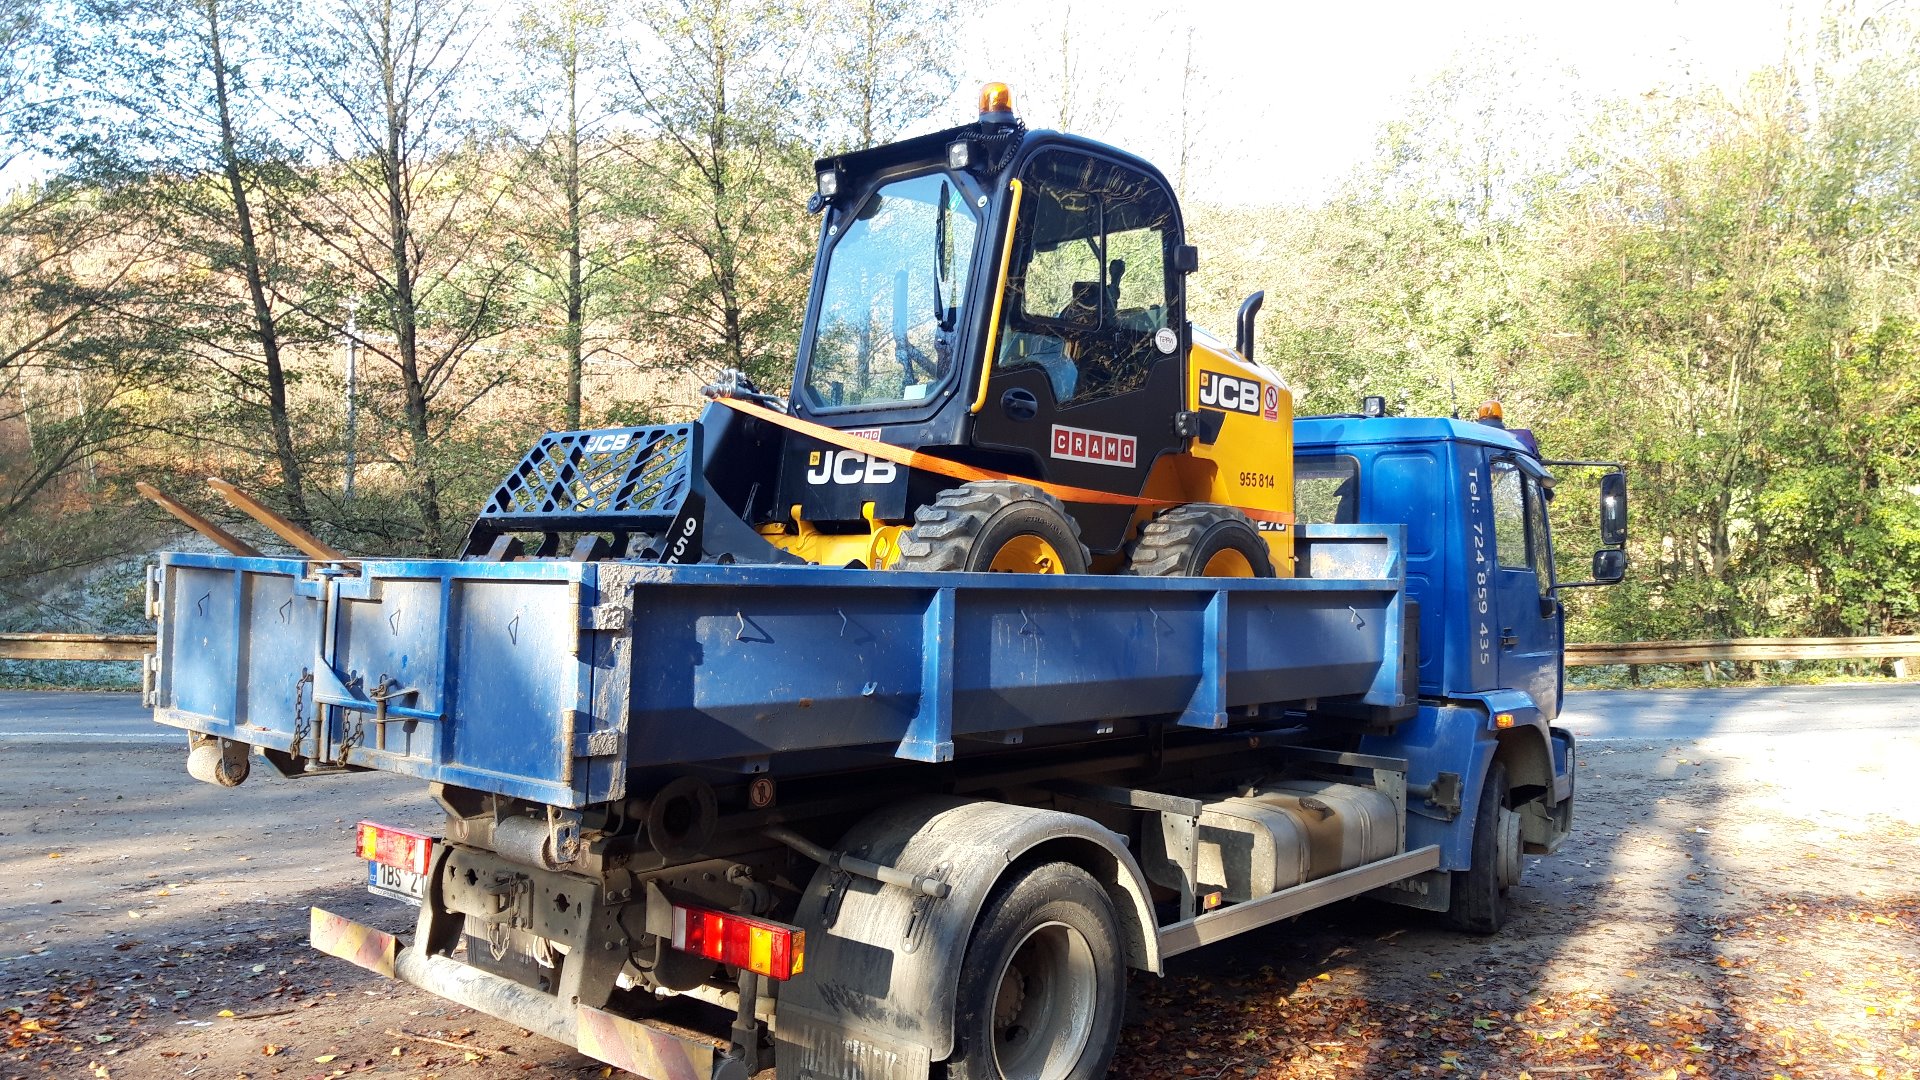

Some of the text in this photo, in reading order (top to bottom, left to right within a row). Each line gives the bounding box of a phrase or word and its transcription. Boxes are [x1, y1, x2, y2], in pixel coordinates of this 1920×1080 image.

[1199, 374, 1260, 413] JCB
[585, 434, 630, 452] JCB
[1056, 433, 1132, 460] CRAMO
[807, 450, 897, 485] JCB
[1240, 472, 1275, 489] 955 814
[1468, 468, 1490, 665] Tel.: 724 859 435
[380, 864, 402, 887] 1BS
